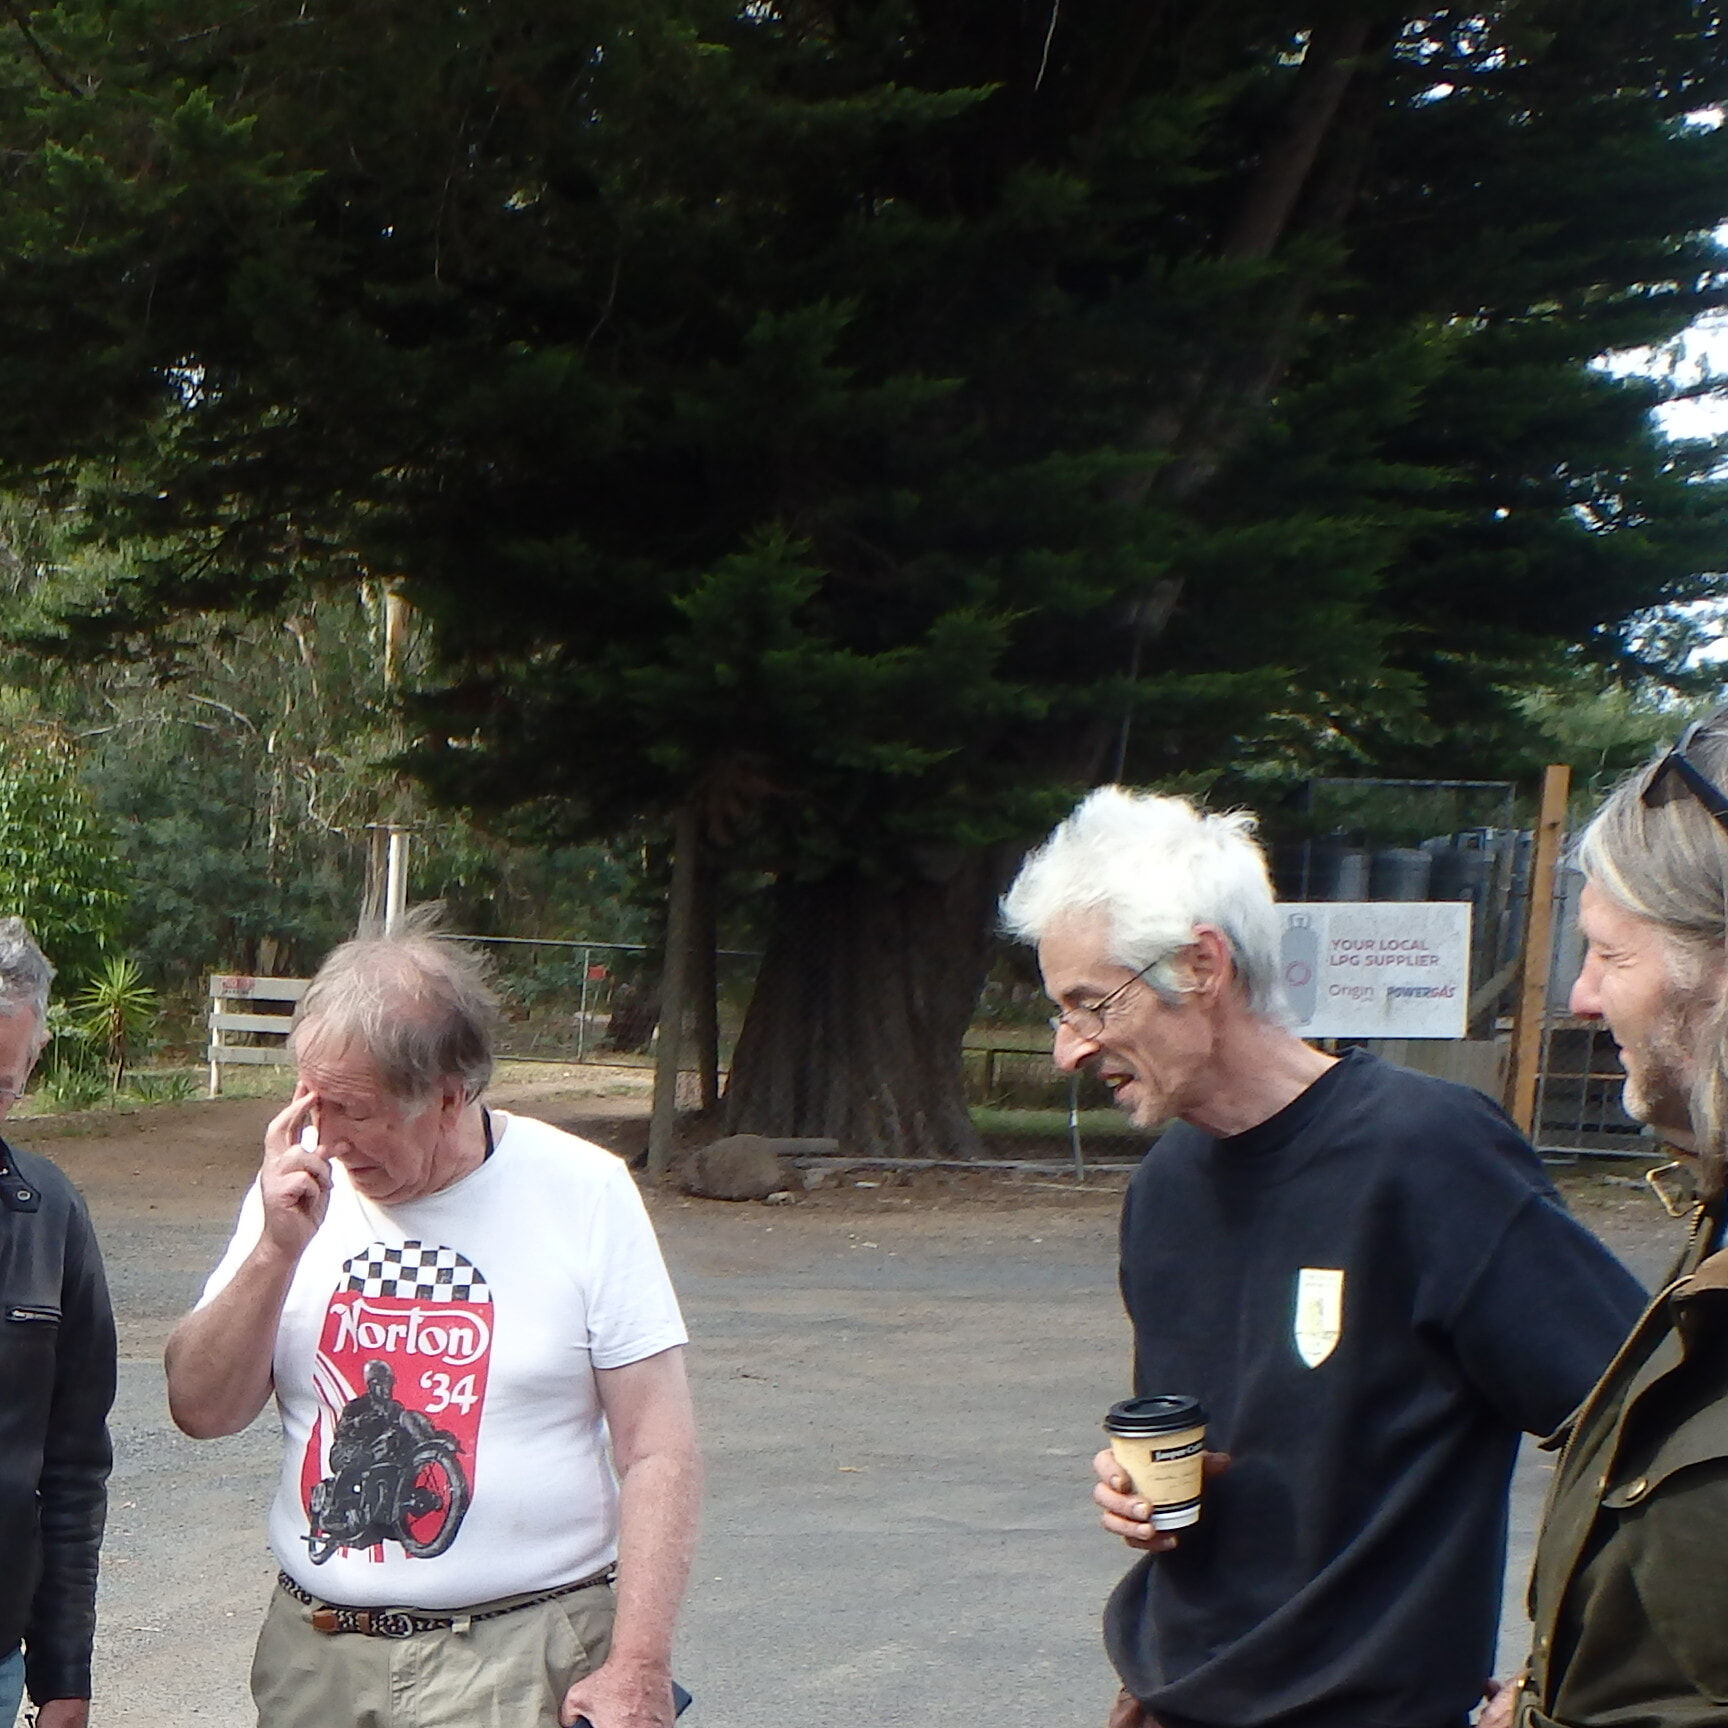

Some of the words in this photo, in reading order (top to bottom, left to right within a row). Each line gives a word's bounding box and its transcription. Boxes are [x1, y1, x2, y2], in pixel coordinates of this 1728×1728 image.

[1330, 939, 1375, 951] YOUR
[1379, 939, 1429, 951] LOCAL
[1329, 954, 1361, 966] LPG
[1365, 954, 1440, 966] SUPPLIER
[1329, 983, 1374, 1000] Origin
[329, 1300, 489, 1365] Norton
